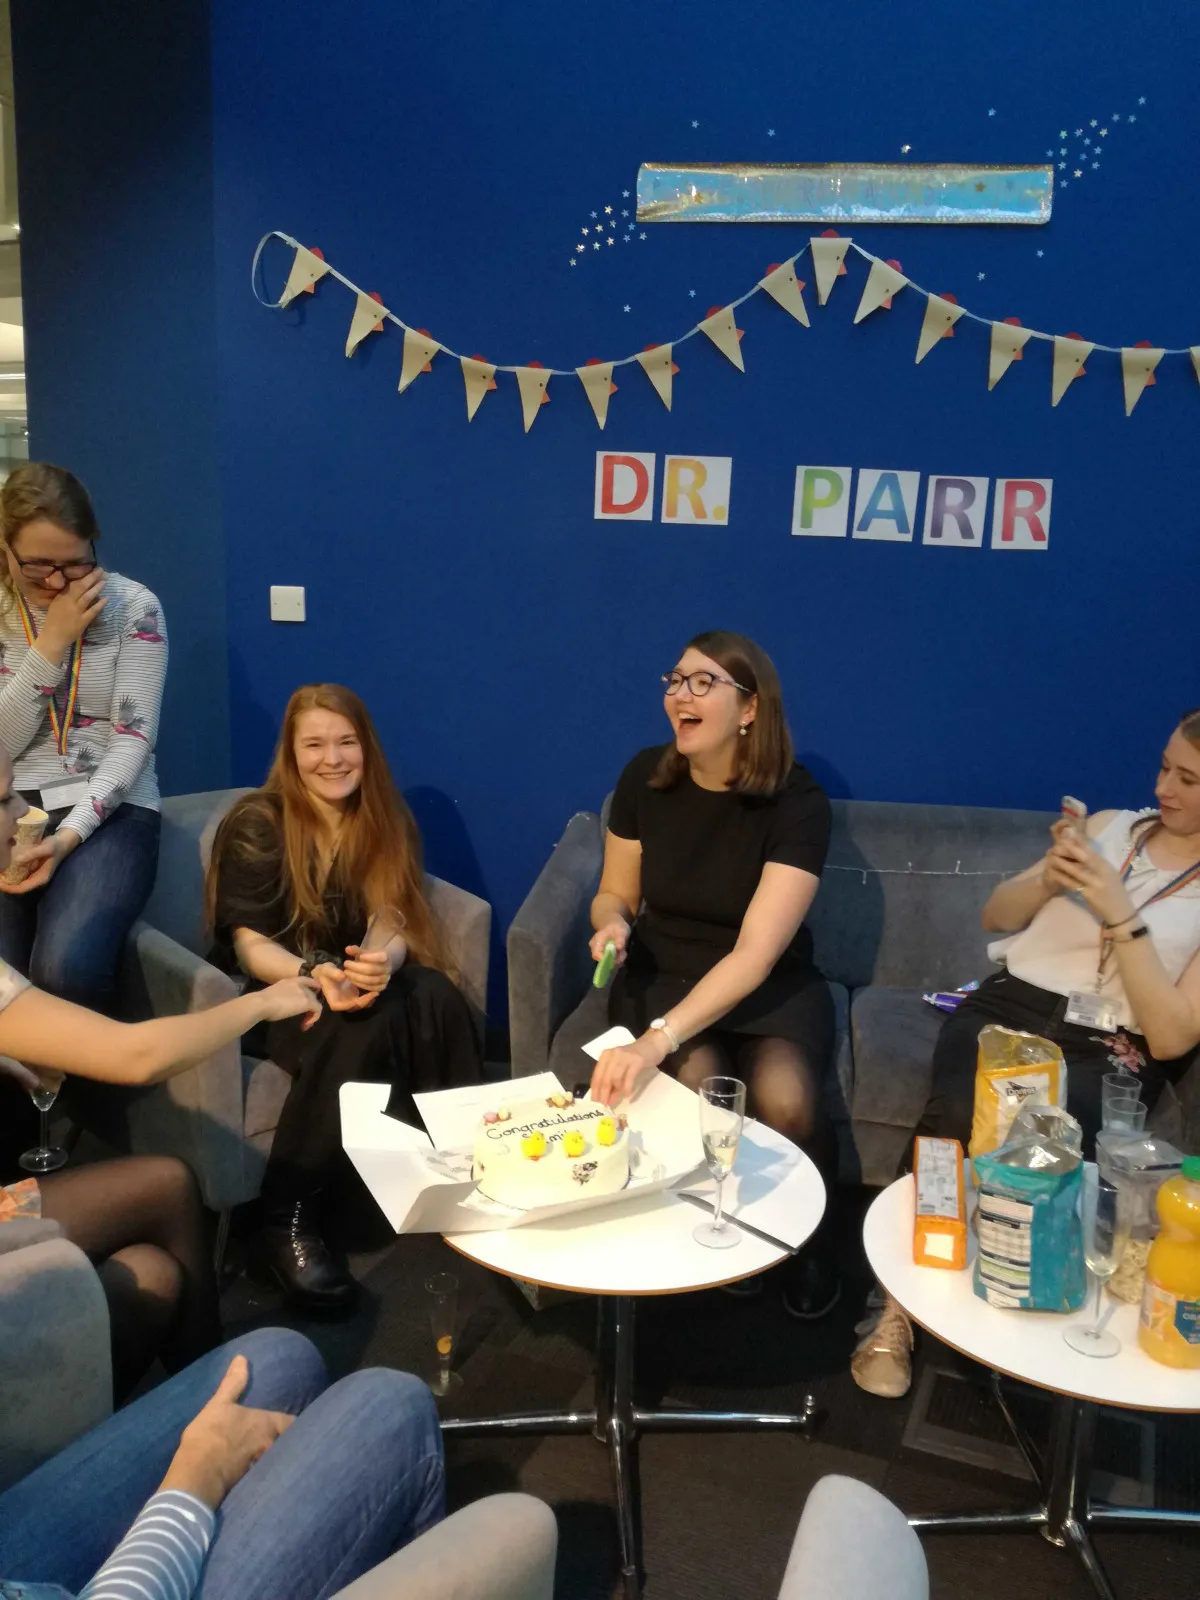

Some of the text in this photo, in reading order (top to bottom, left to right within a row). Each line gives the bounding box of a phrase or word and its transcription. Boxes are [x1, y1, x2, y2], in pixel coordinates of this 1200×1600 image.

[600, 453, 1047, 542] DR. PARR
[486, 1109, 605, 1140] Congratulations
